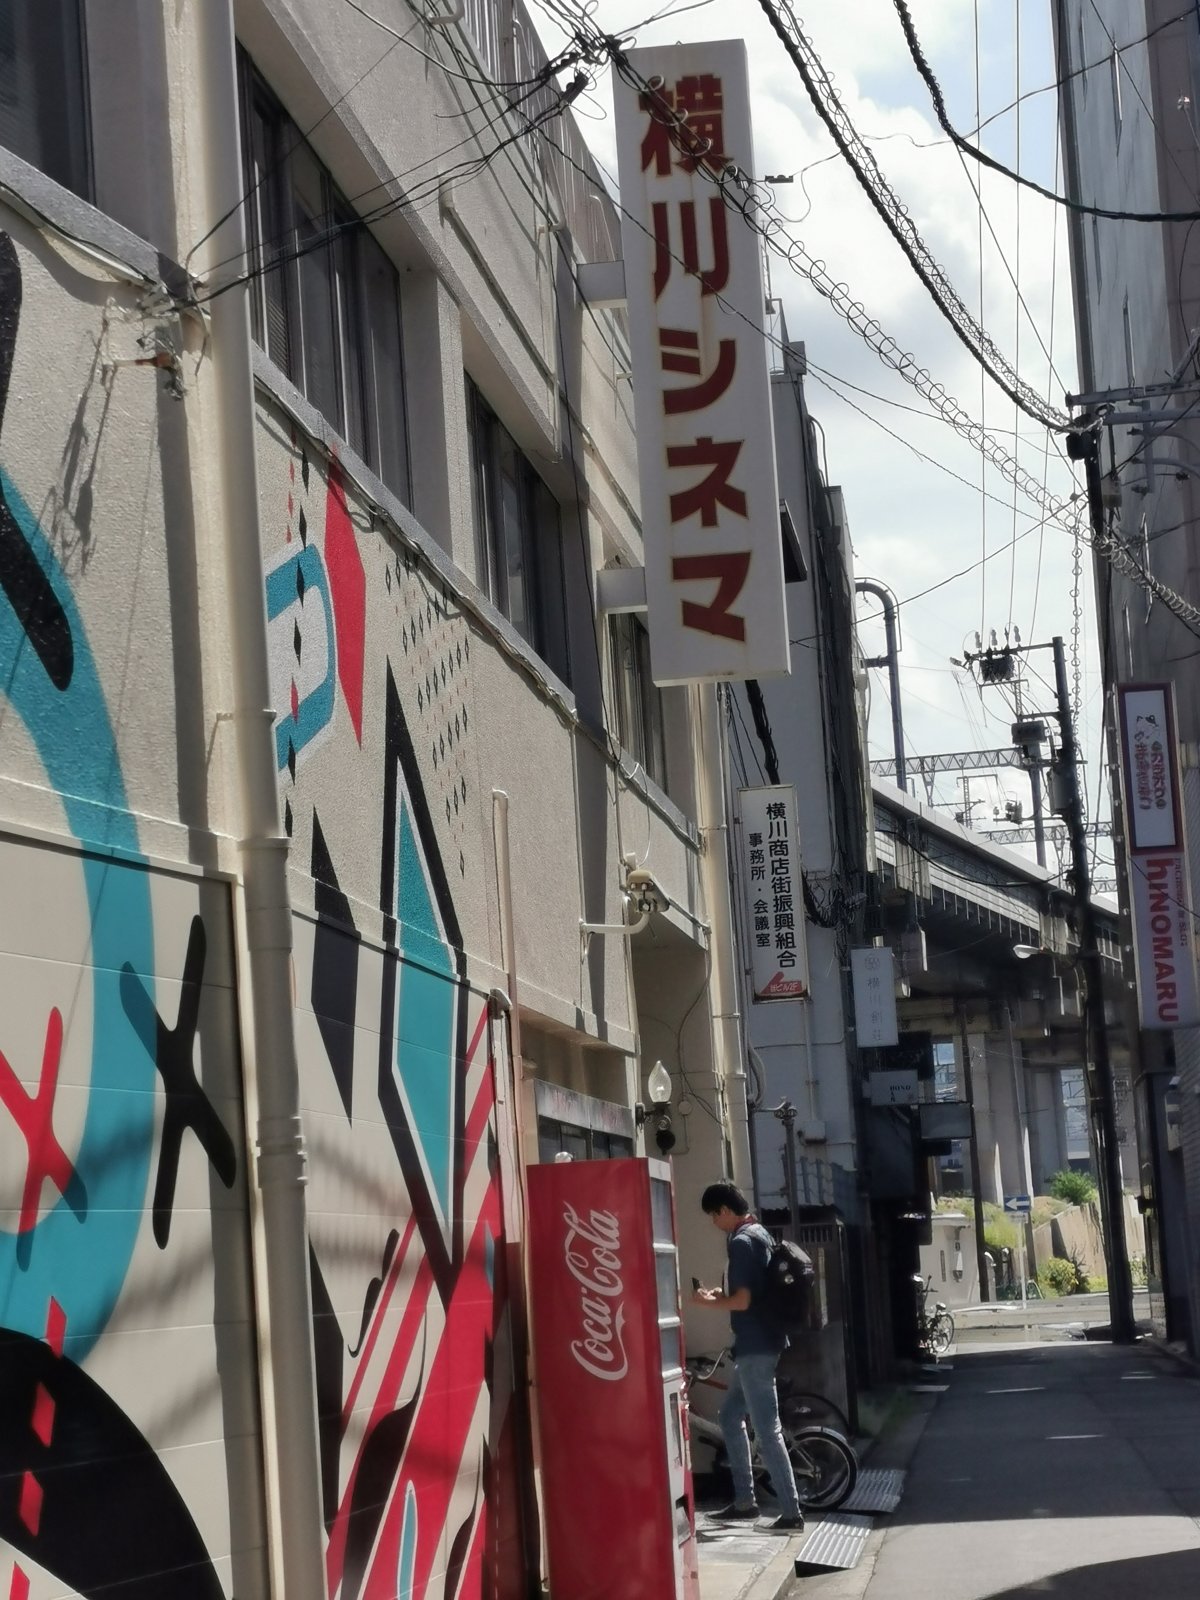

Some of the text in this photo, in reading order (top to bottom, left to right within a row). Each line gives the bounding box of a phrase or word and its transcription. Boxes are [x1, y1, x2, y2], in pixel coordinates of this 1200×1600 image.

[638, 74, 752, 642] 横川シネマ
[749, 832, 771, 948] 事務所・会議室
[766, 802, 797, 968] 横川商店街振興組合
